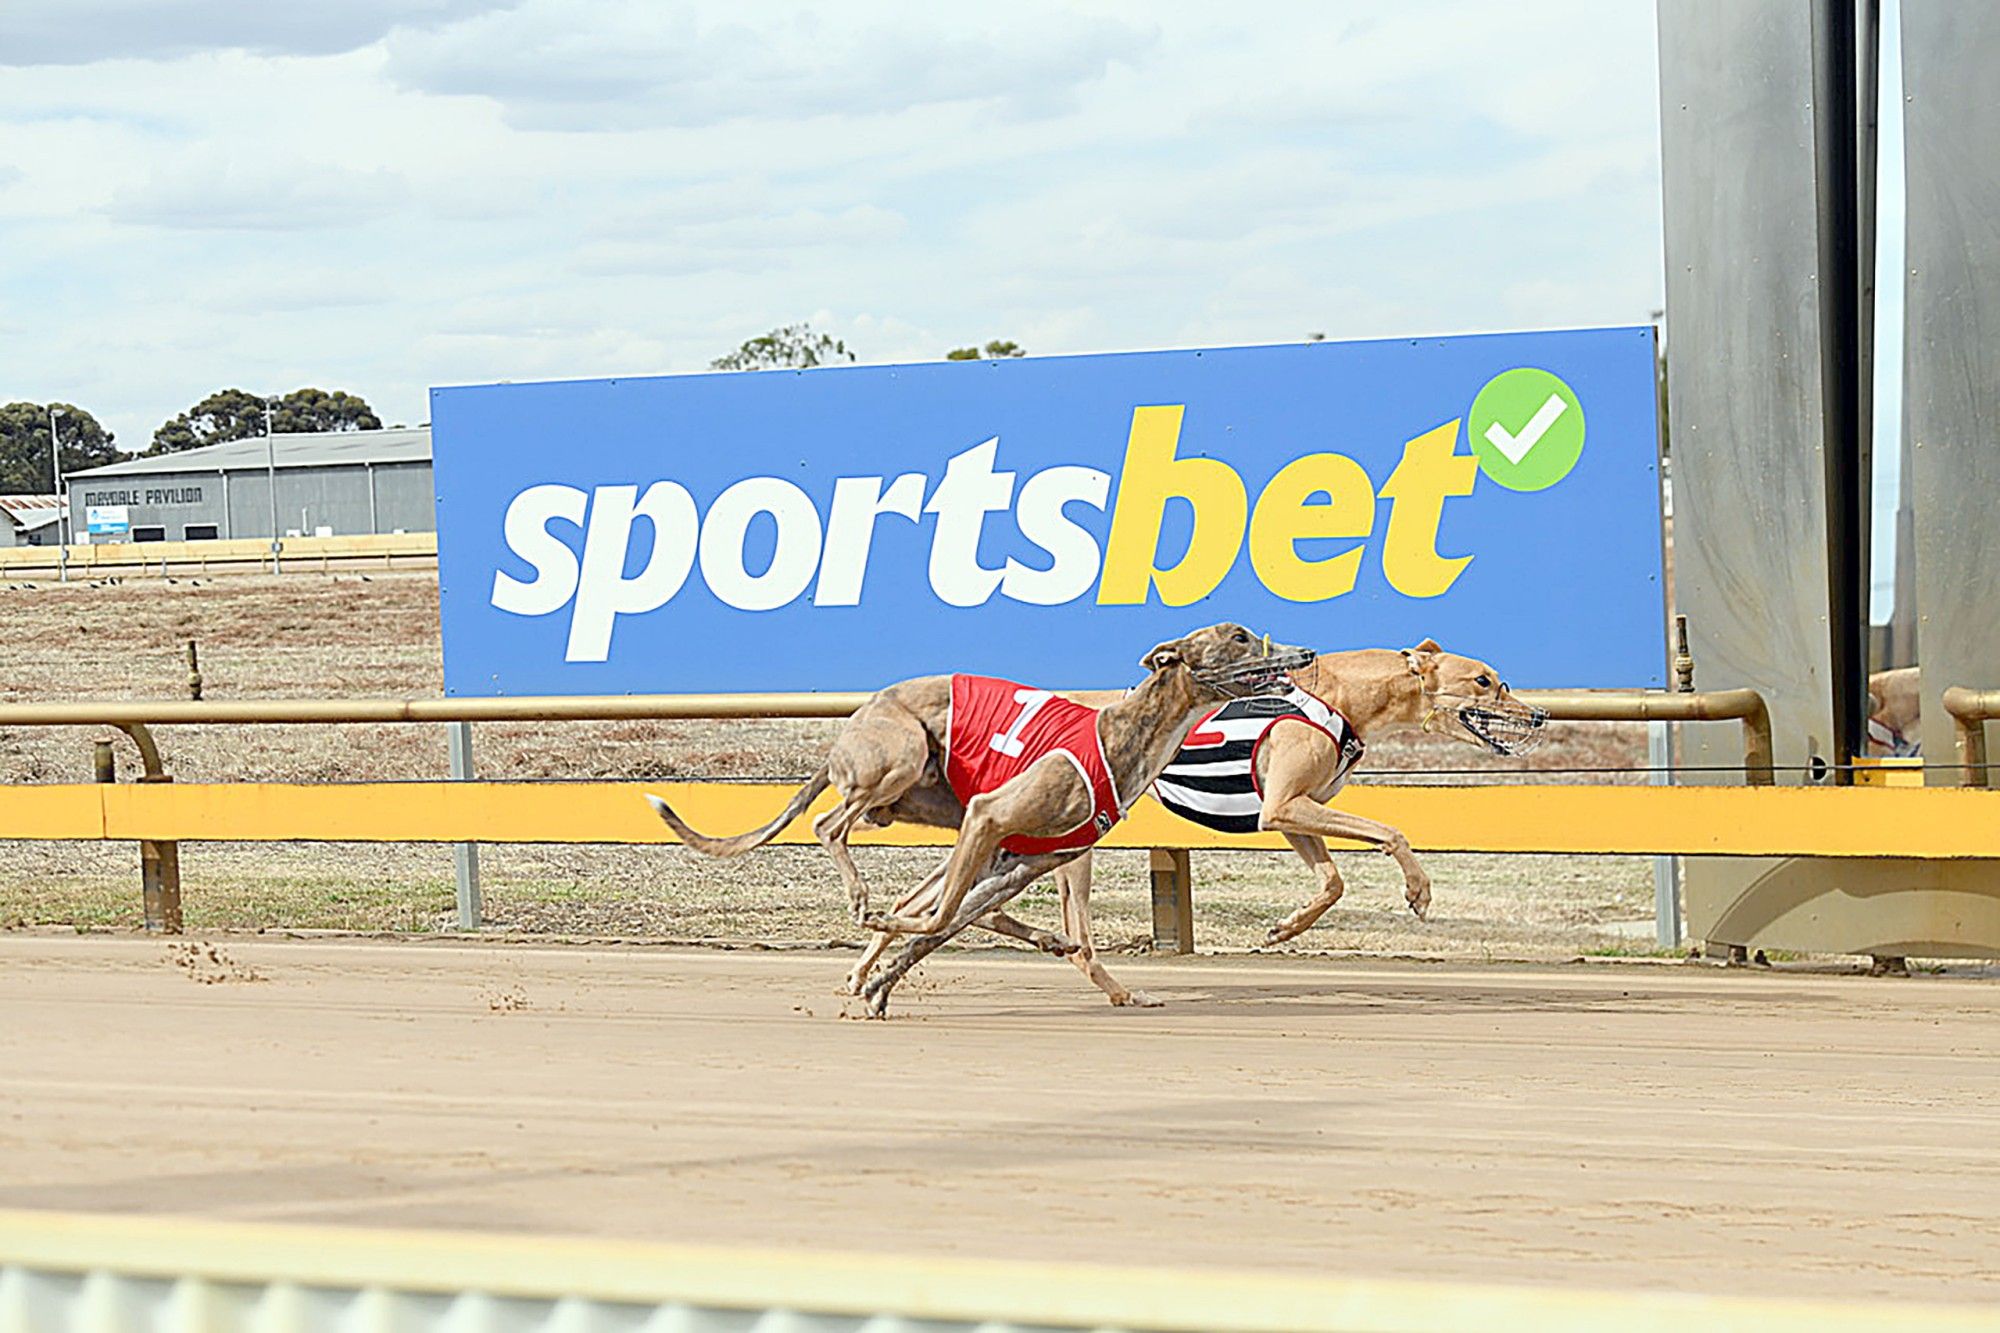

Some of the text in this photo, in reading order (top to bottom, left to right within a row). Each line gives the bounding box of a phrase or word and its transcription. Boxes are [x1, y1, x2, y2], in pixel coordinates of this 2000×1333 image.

[85, 487, 202, 507] MAYDALE PAVILION
[491, 404, 1480, 662] sportsbet
[989, 689, 1054, 758] 1
